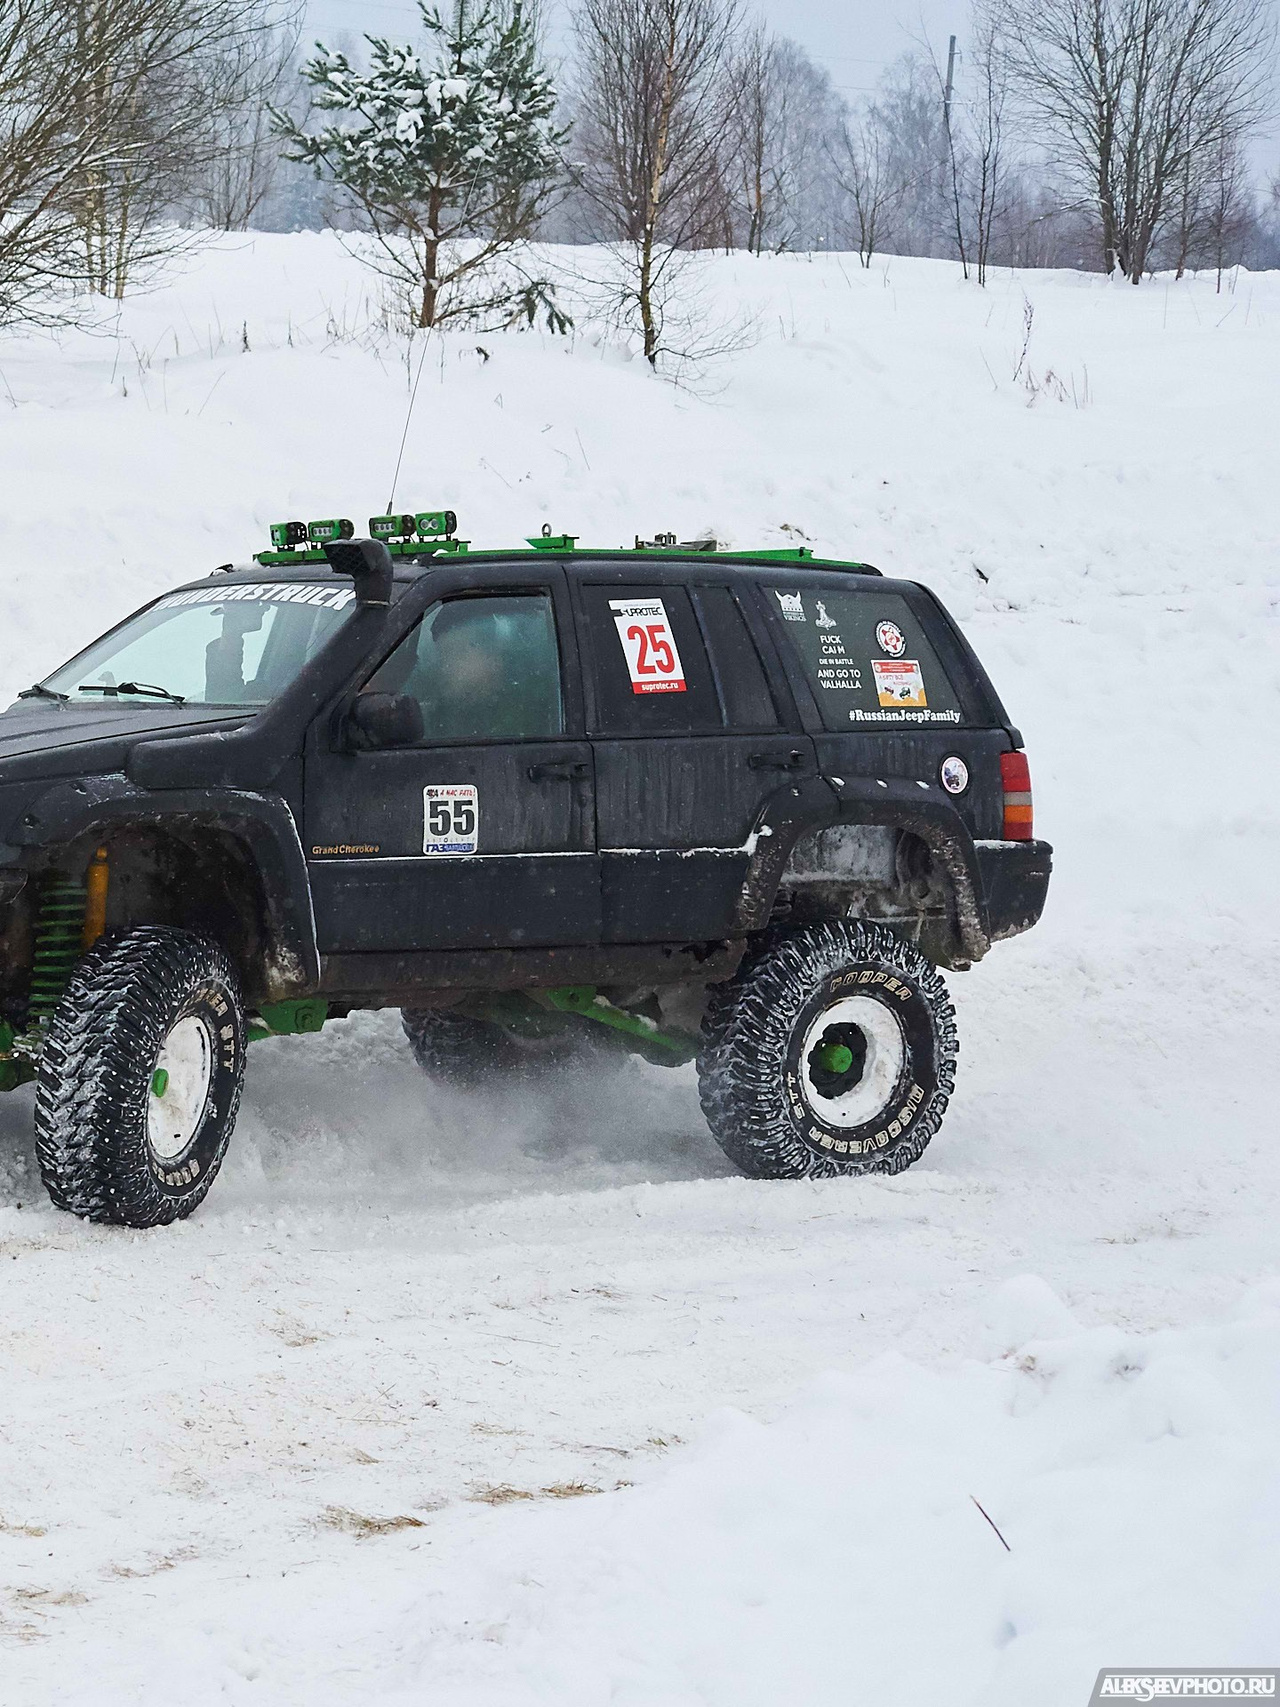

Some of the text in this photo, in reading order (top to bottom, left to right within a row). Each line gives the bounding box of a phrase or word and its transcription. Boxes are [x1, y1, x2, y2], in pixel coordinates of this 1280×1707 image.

[819, 635, 842, 644] FUCK
[627, 624, 675, 674] 25
[817, 669, 861, 678] AND GO TO
[641, 682, 679, 693] suprotec.ru
[820, 680, 862, 689] VALHALLA
[848, 709, 961, 723] #RussianJeepFamily
[429, 800, 475, 836] 55
[829, 970, 913, 1001] COOPER
